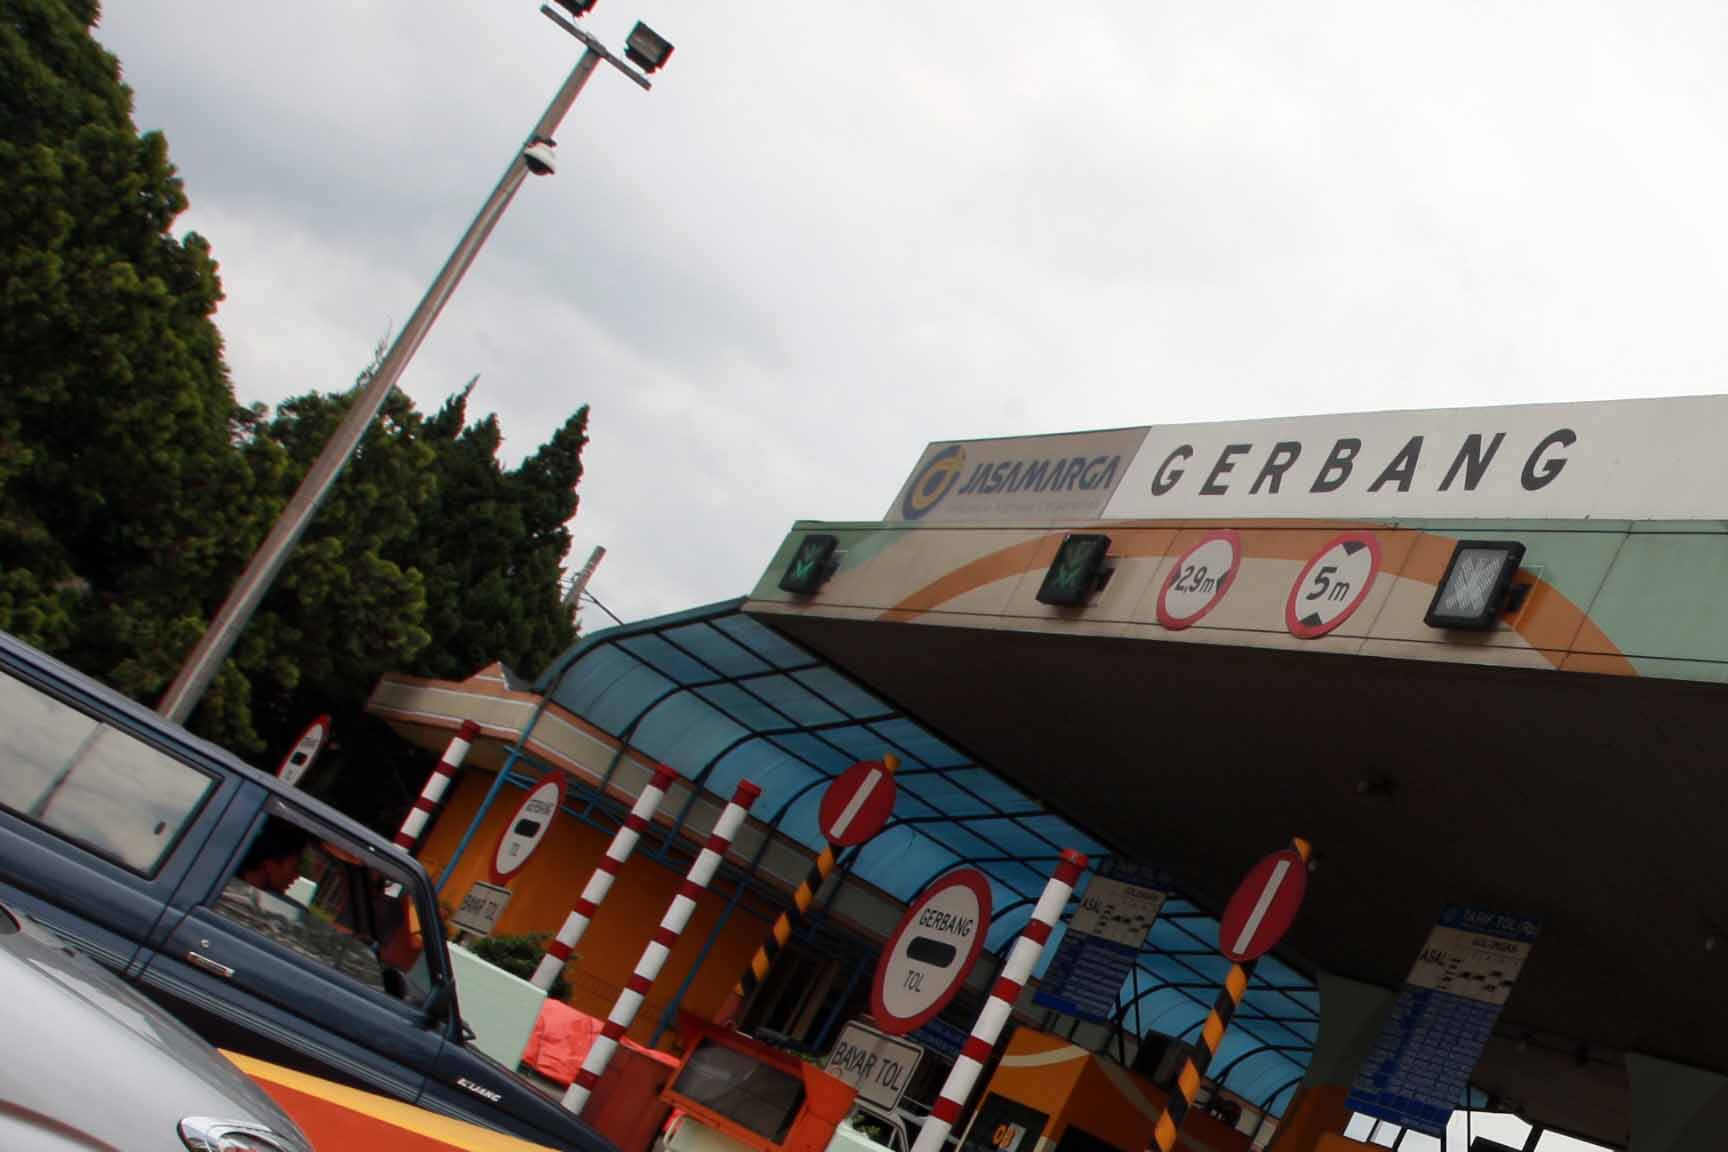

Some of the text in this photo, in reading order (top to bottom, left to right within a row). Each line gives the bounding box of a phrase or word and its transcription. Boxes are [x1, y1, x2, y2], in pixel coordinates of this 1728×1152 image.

[1151, 427, 1577, 497] GERBANG
[919, 908, 973, 937] GERBANG
[903, 970, 924, 992] TOL
[831, 1042, 903, 1091] BAYAR TOL
